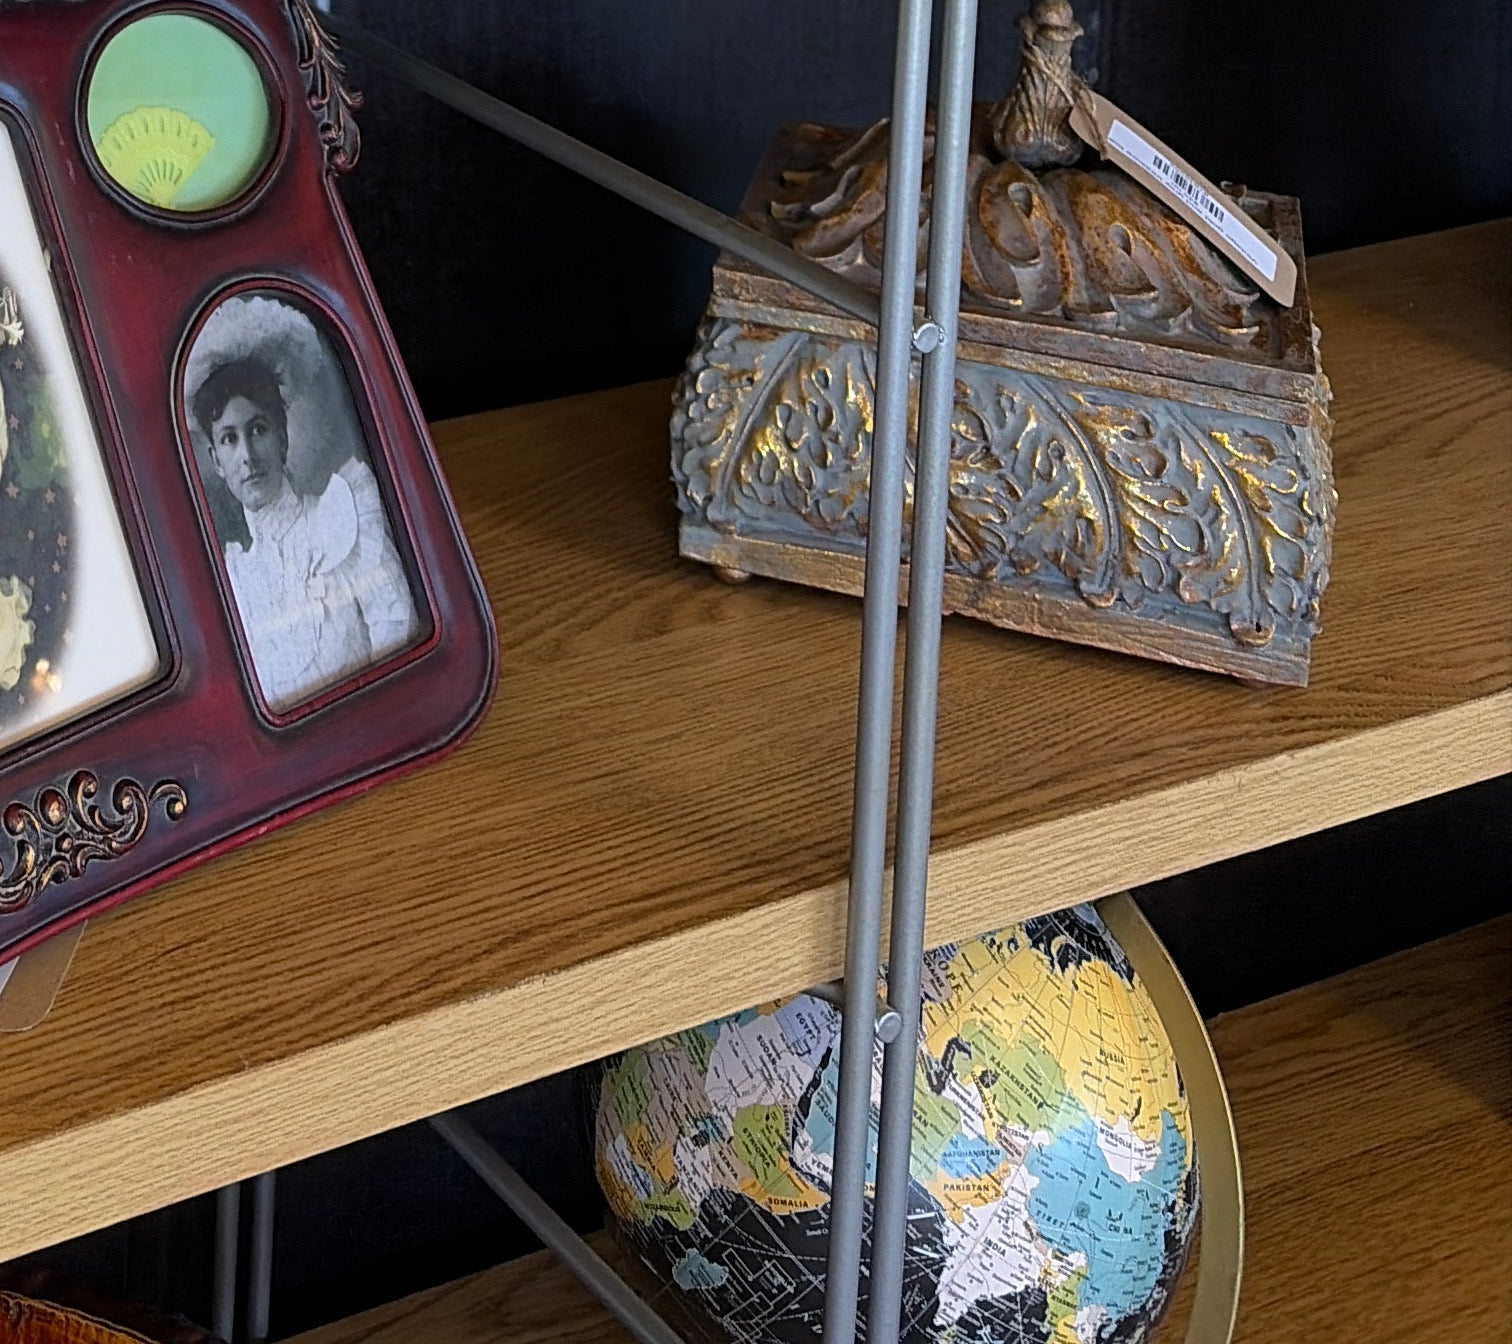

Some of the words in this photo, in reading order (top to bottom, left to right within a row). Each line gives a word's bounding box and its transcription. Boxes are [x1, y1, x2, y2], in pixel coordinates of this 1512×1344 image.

[795, 1012, 817, 1041] EGYPT
[756, 1034, 778, 1066] SUDAN
[1099, 1127, 1133, 1150] MONGOLIA
[717, 1150, 739, 1180] KENYA
[943, 1183, 990, 1192] PAKISTAN
[767, 1196, 809, 1209] SOMALIA
[983, 1236, 1007, 1258] INDIA
